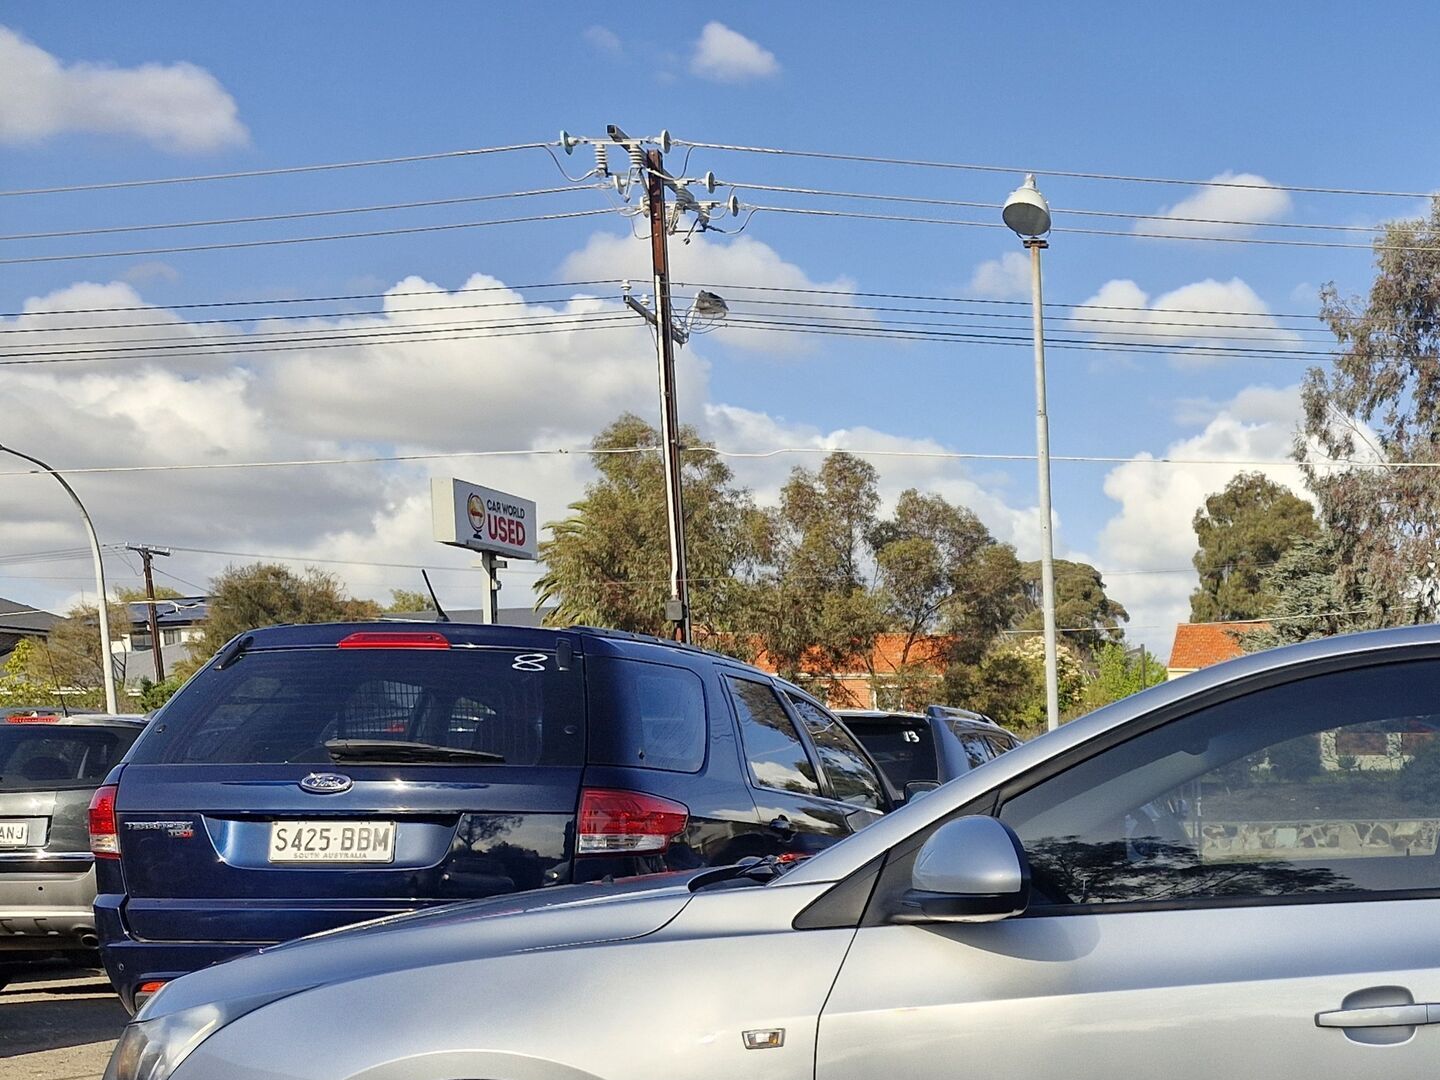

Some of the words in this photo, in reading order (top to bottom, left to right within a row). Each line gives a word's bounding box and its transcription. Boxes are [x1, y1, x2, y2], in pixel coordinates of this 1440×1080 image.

[487, 499, 501, 515] CAR
[502, 503, 525, 519] WORLD
[486, 514, 526, 547] USED
[511, 653, 549, 672] 8
[902, 730, 920, 743] 13
